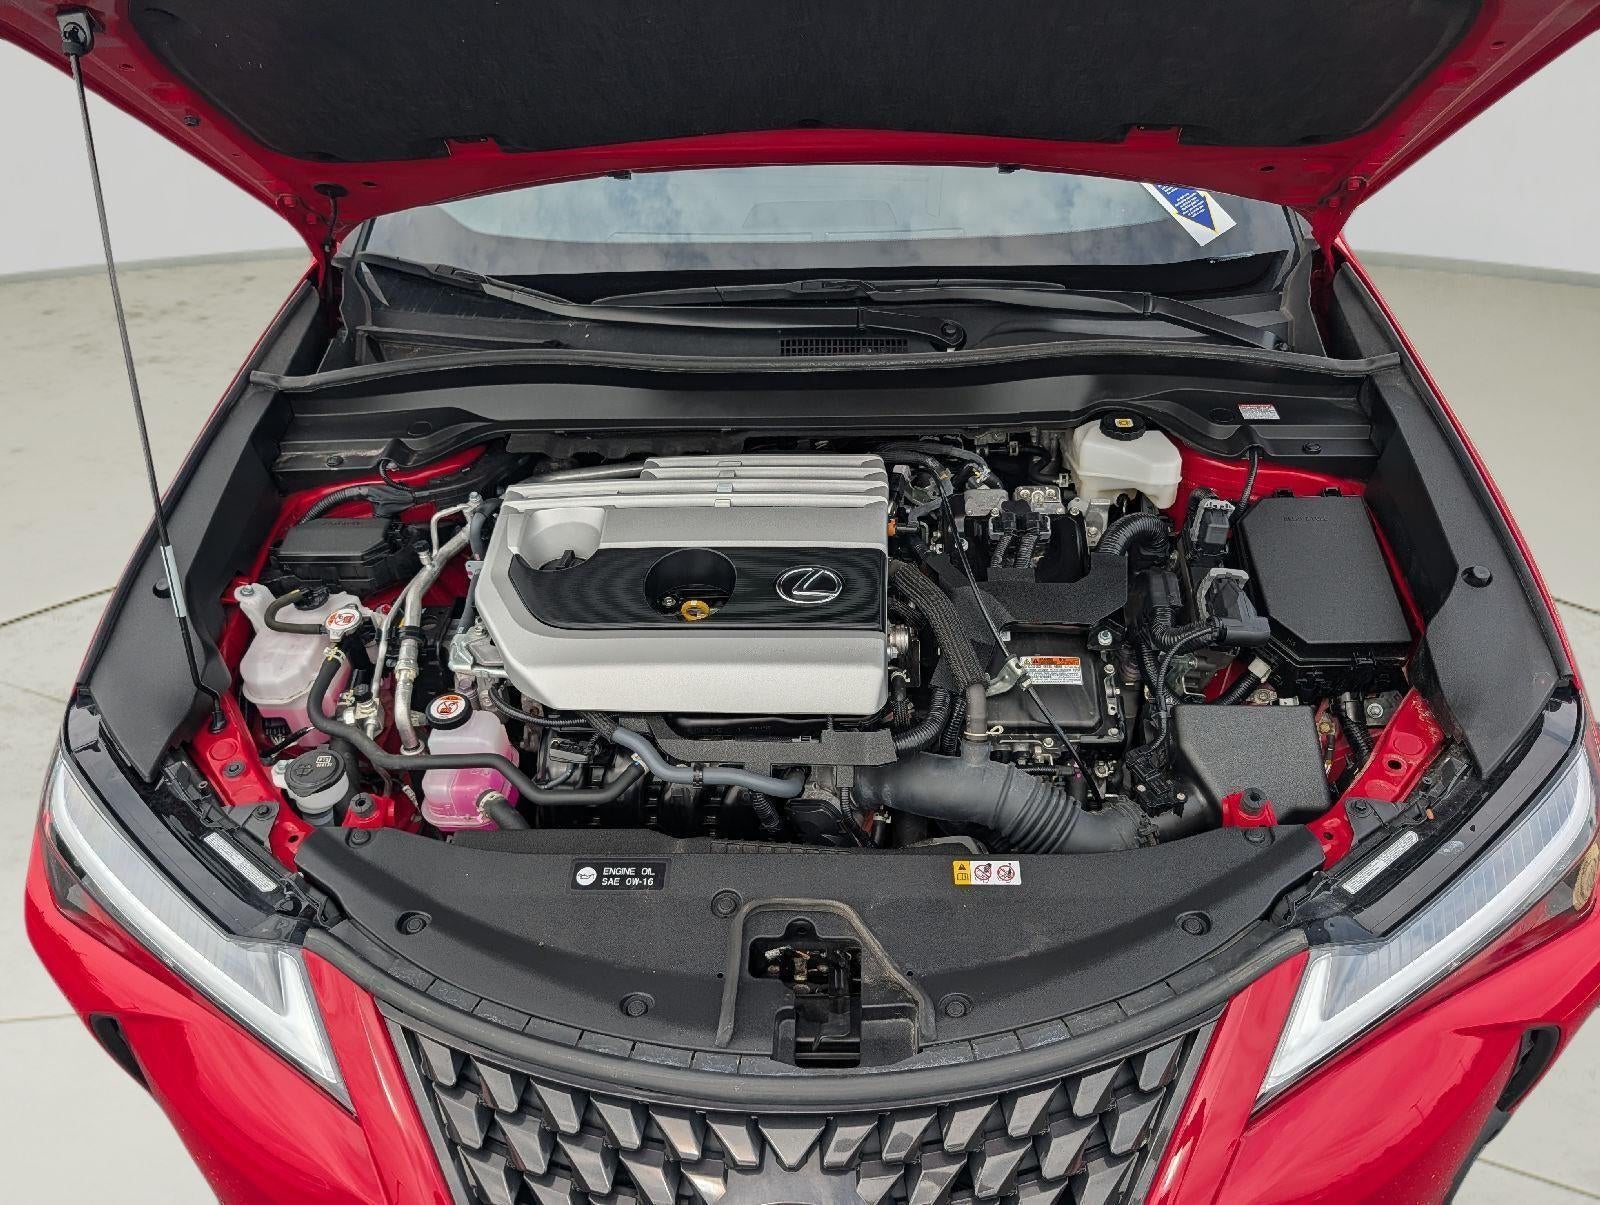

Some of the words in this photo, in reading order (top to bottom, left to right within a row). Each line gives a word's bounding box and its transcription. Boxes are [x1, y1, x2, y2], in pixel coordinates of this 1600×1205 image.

[603, 867, 636, 876] ENGINE
[641, 867, 656, 876] OIL
[601, 877, 620, 886] SAE
[625, 877, 654, 886] 0W-16
